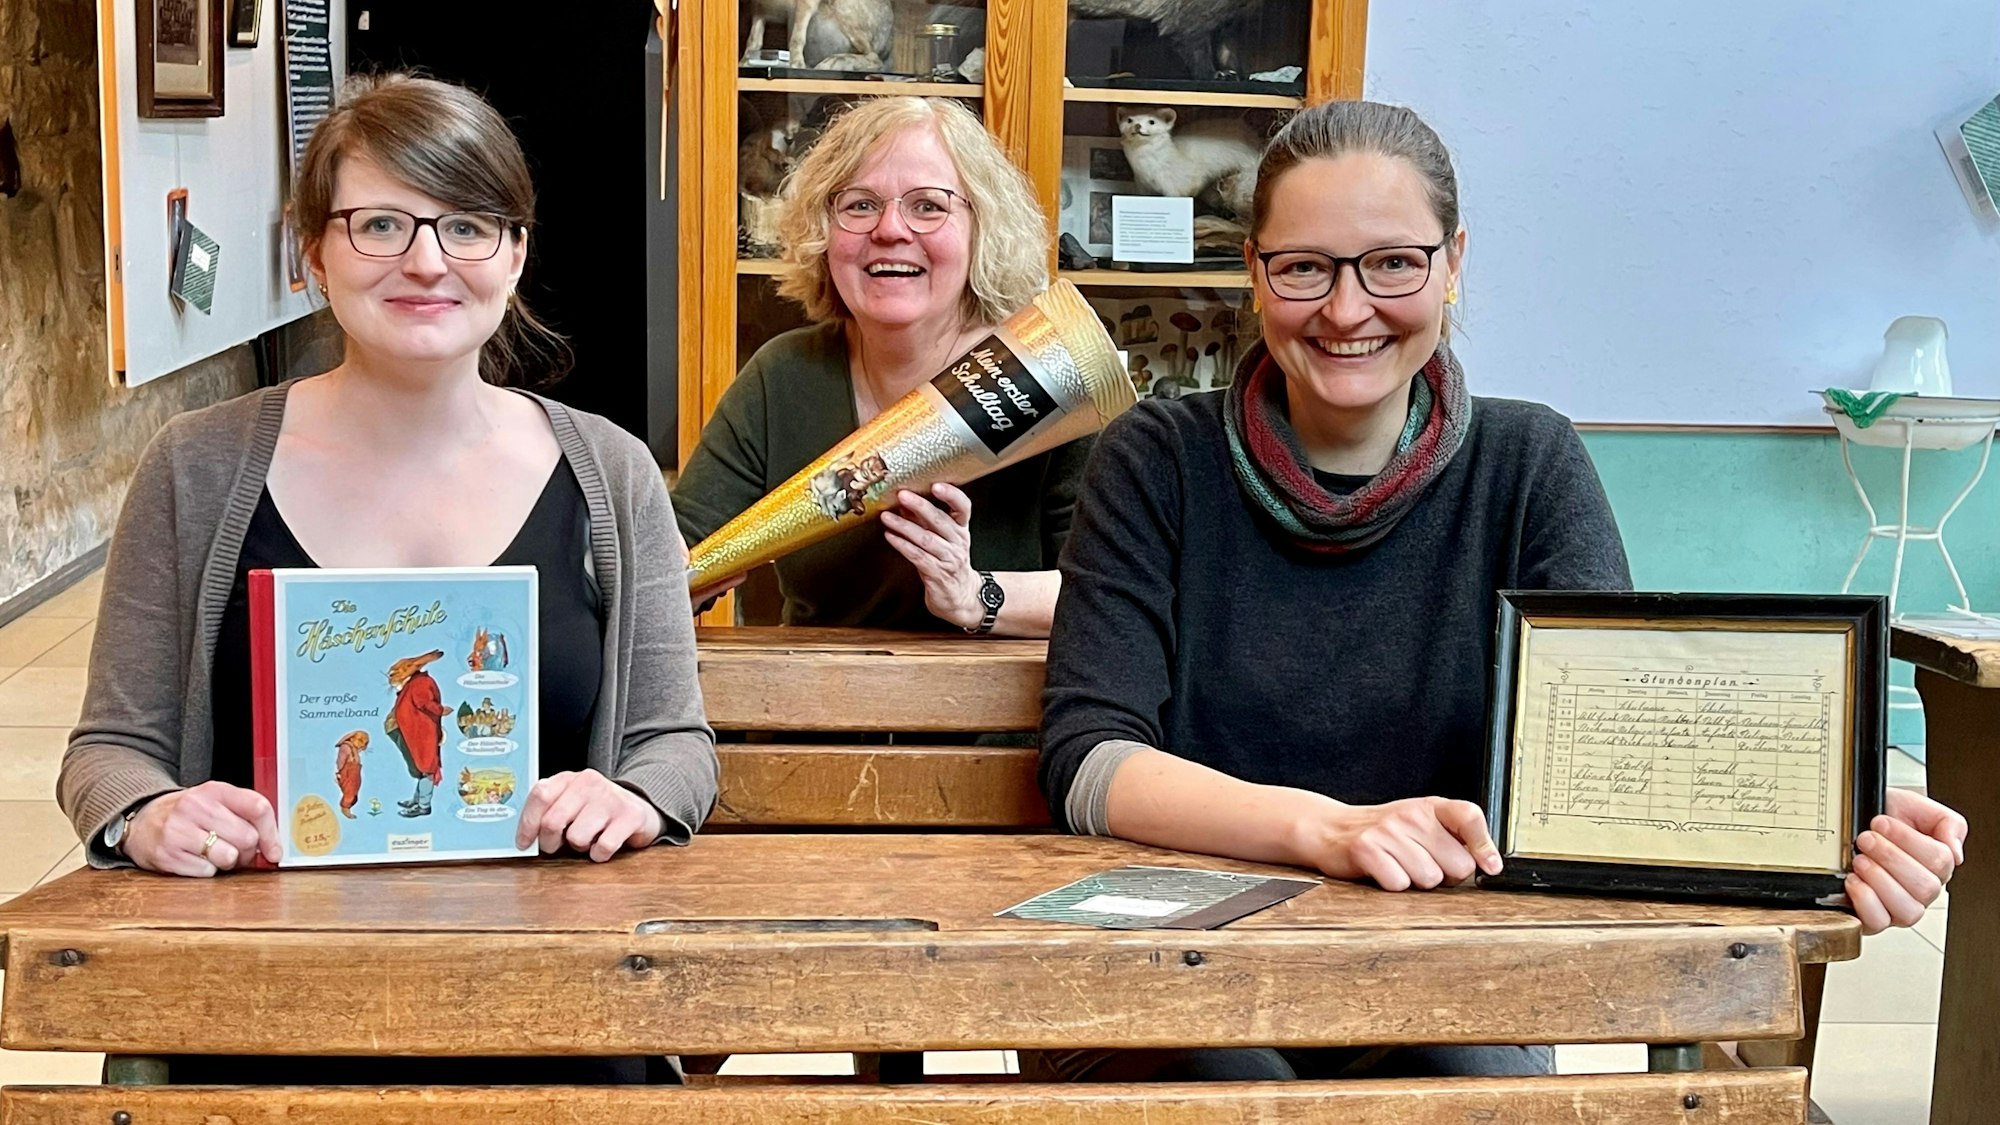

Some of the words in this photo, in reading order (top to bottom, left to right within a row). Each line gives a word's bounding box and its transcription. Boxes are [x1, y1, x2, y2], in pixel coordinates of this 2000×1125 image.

[970, 348, 1002, 379] Mein
[997, 376, 1039, 418] erster
[951, 361, 1014, 431] Schultag
[331, 600, 358, 614] Die
[298, 694, 320, 704] Der
[323, 692, 358, 706] große
[298, 707, 380, 719] Sammelband
